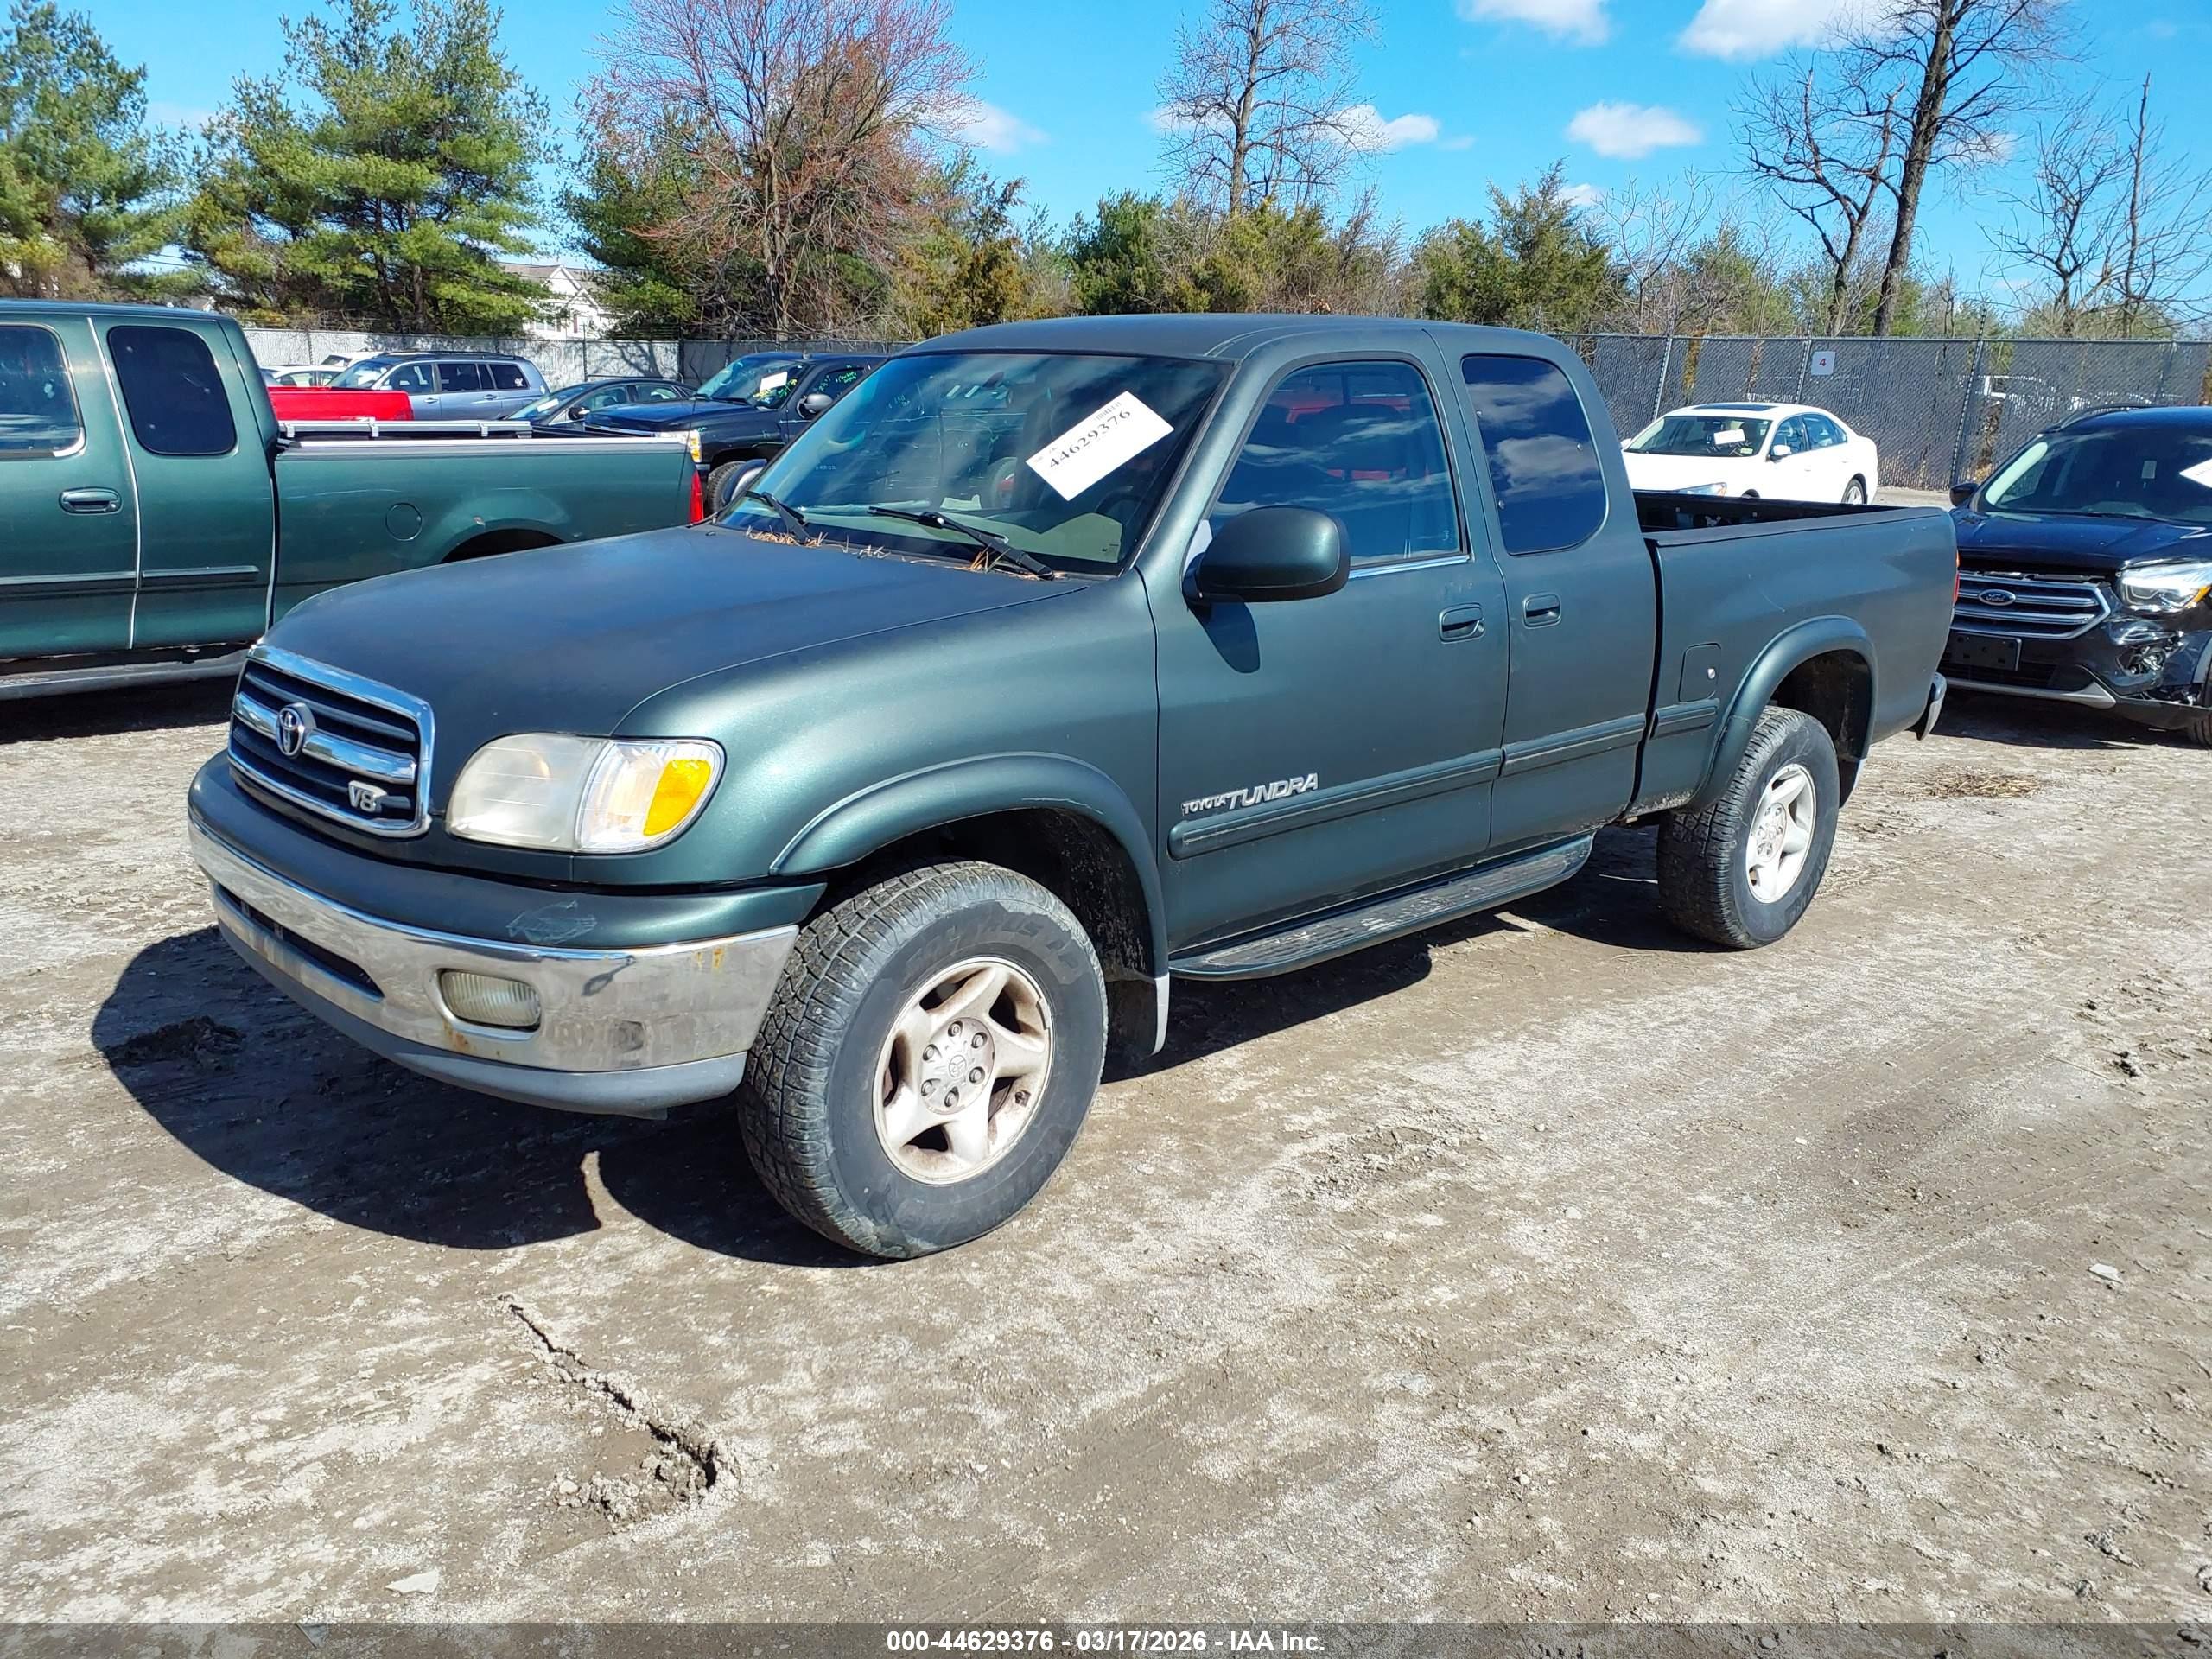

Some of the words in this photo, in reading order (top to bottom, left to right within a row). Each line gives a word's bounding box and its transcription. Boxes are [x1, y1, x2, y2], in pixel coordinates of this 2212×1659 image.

[1818, 358, 1827, 367] 4
[1049, 410, 1131, 468] 44629376
[348, 780, 383, 812] V8
[1182, 793, 1226, 816] TOYOTA
[1225, 772, 1319, 810] TUNDRA
